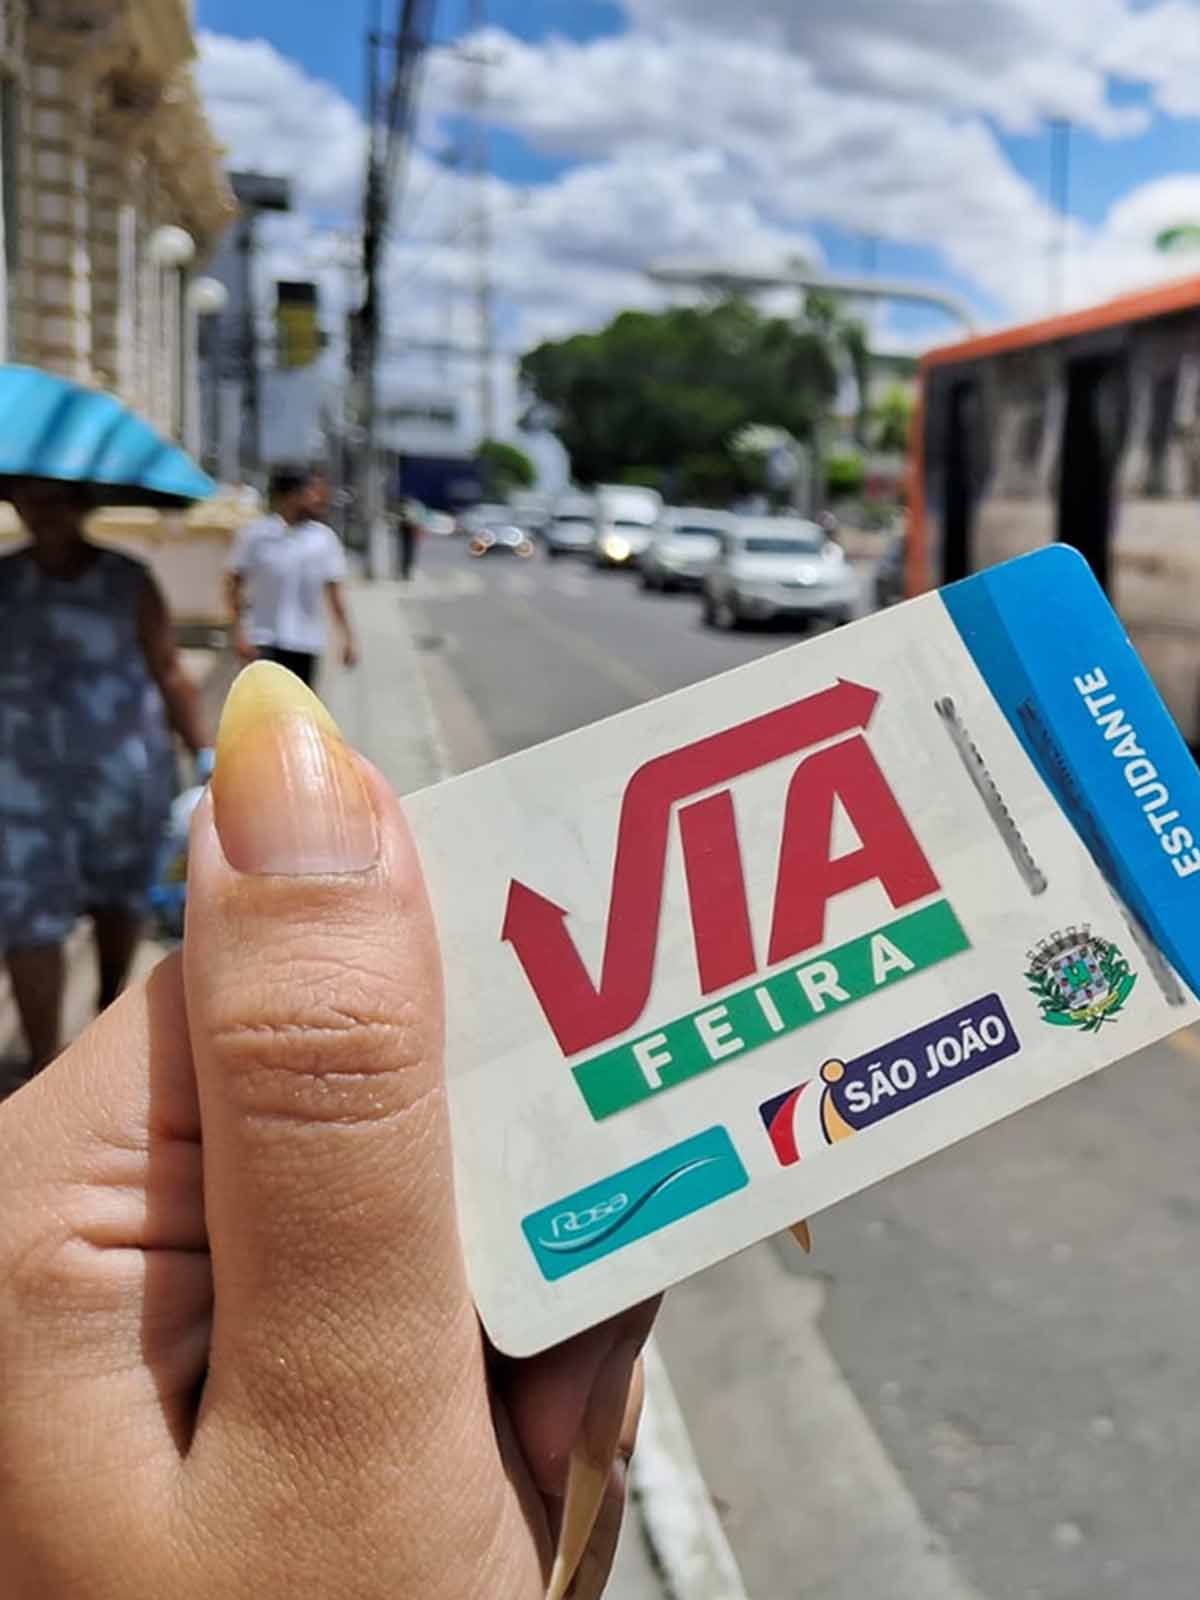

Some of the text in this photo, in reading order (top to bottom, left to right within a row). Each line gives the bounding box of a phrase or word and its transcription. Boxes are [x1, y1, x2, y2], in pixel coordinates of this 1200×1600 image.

[500, 676, 942, 1058] VIA
[632, 932, 917, 1090] FEIRA
[844, 1014, 1007, 1113] SÃO JOÃO
[550, 1192, 629, 1238] Rosa
